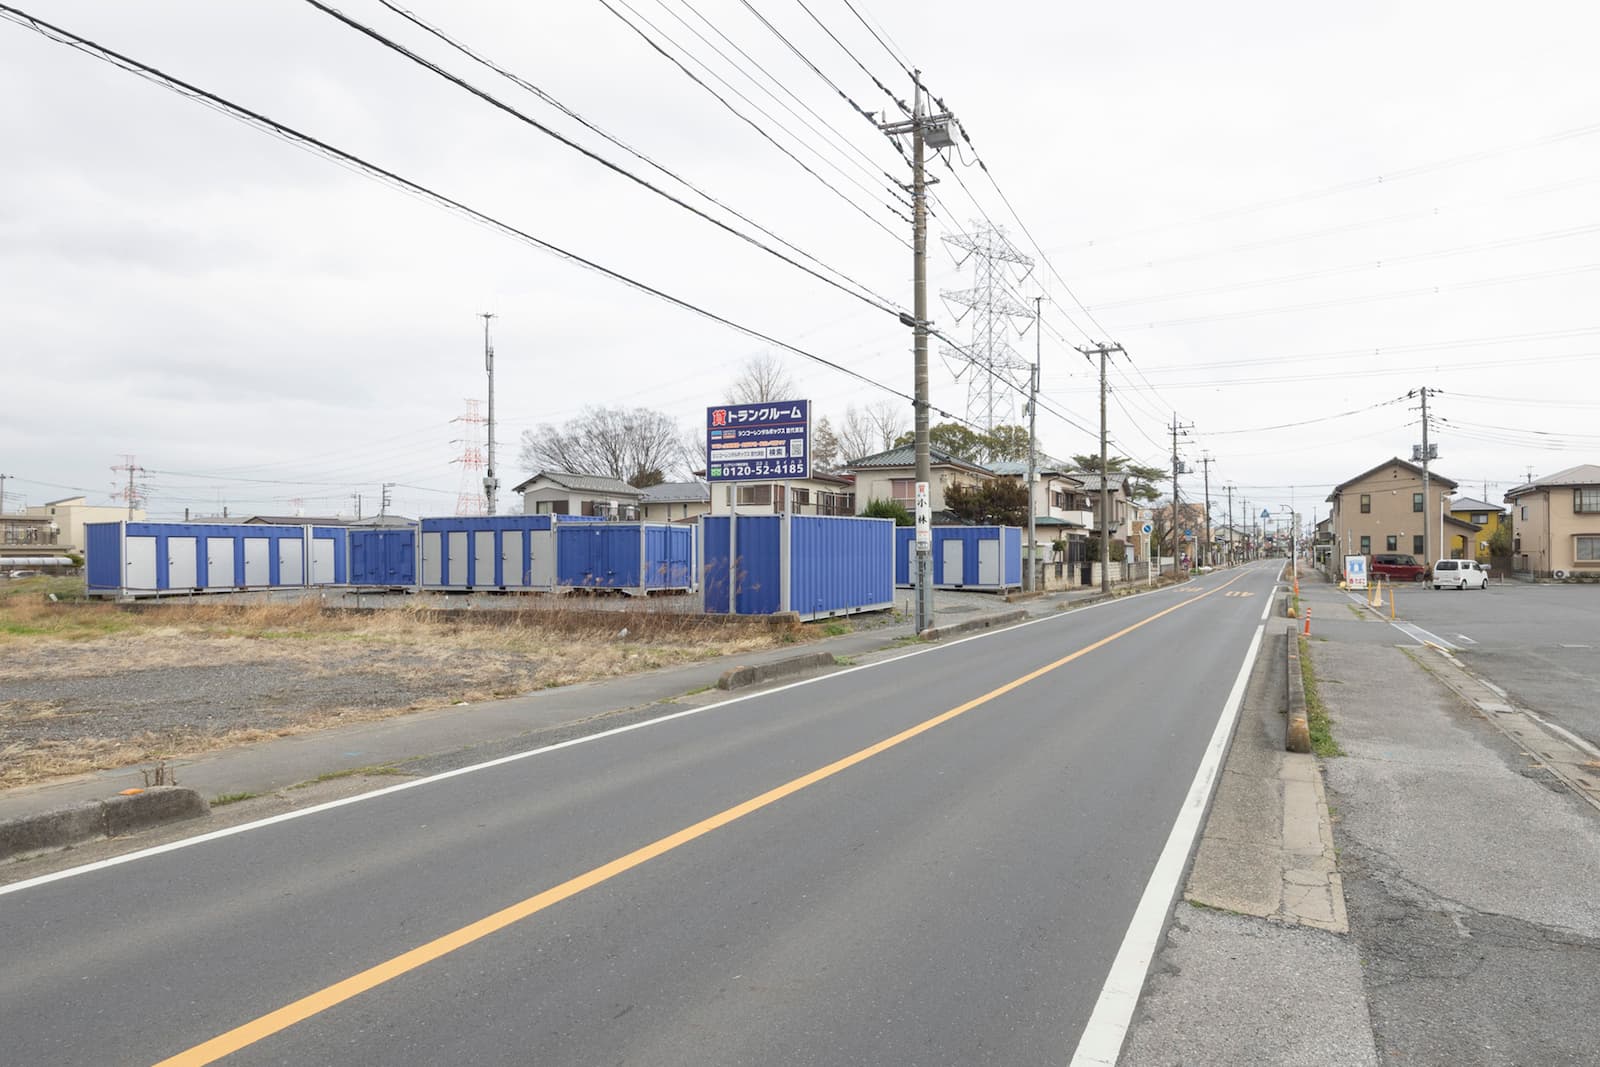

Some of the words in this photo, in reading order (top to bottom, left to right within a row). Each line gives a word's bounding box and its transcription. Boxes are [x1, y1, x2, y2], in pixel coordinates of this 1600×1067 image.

[728, 406, 802, 423] トランクルーム
[769, 447, 783, 457] 検索
[723, 464, 804, 476] 0120-52-4185
[917, 498, 927, 525] 小林
